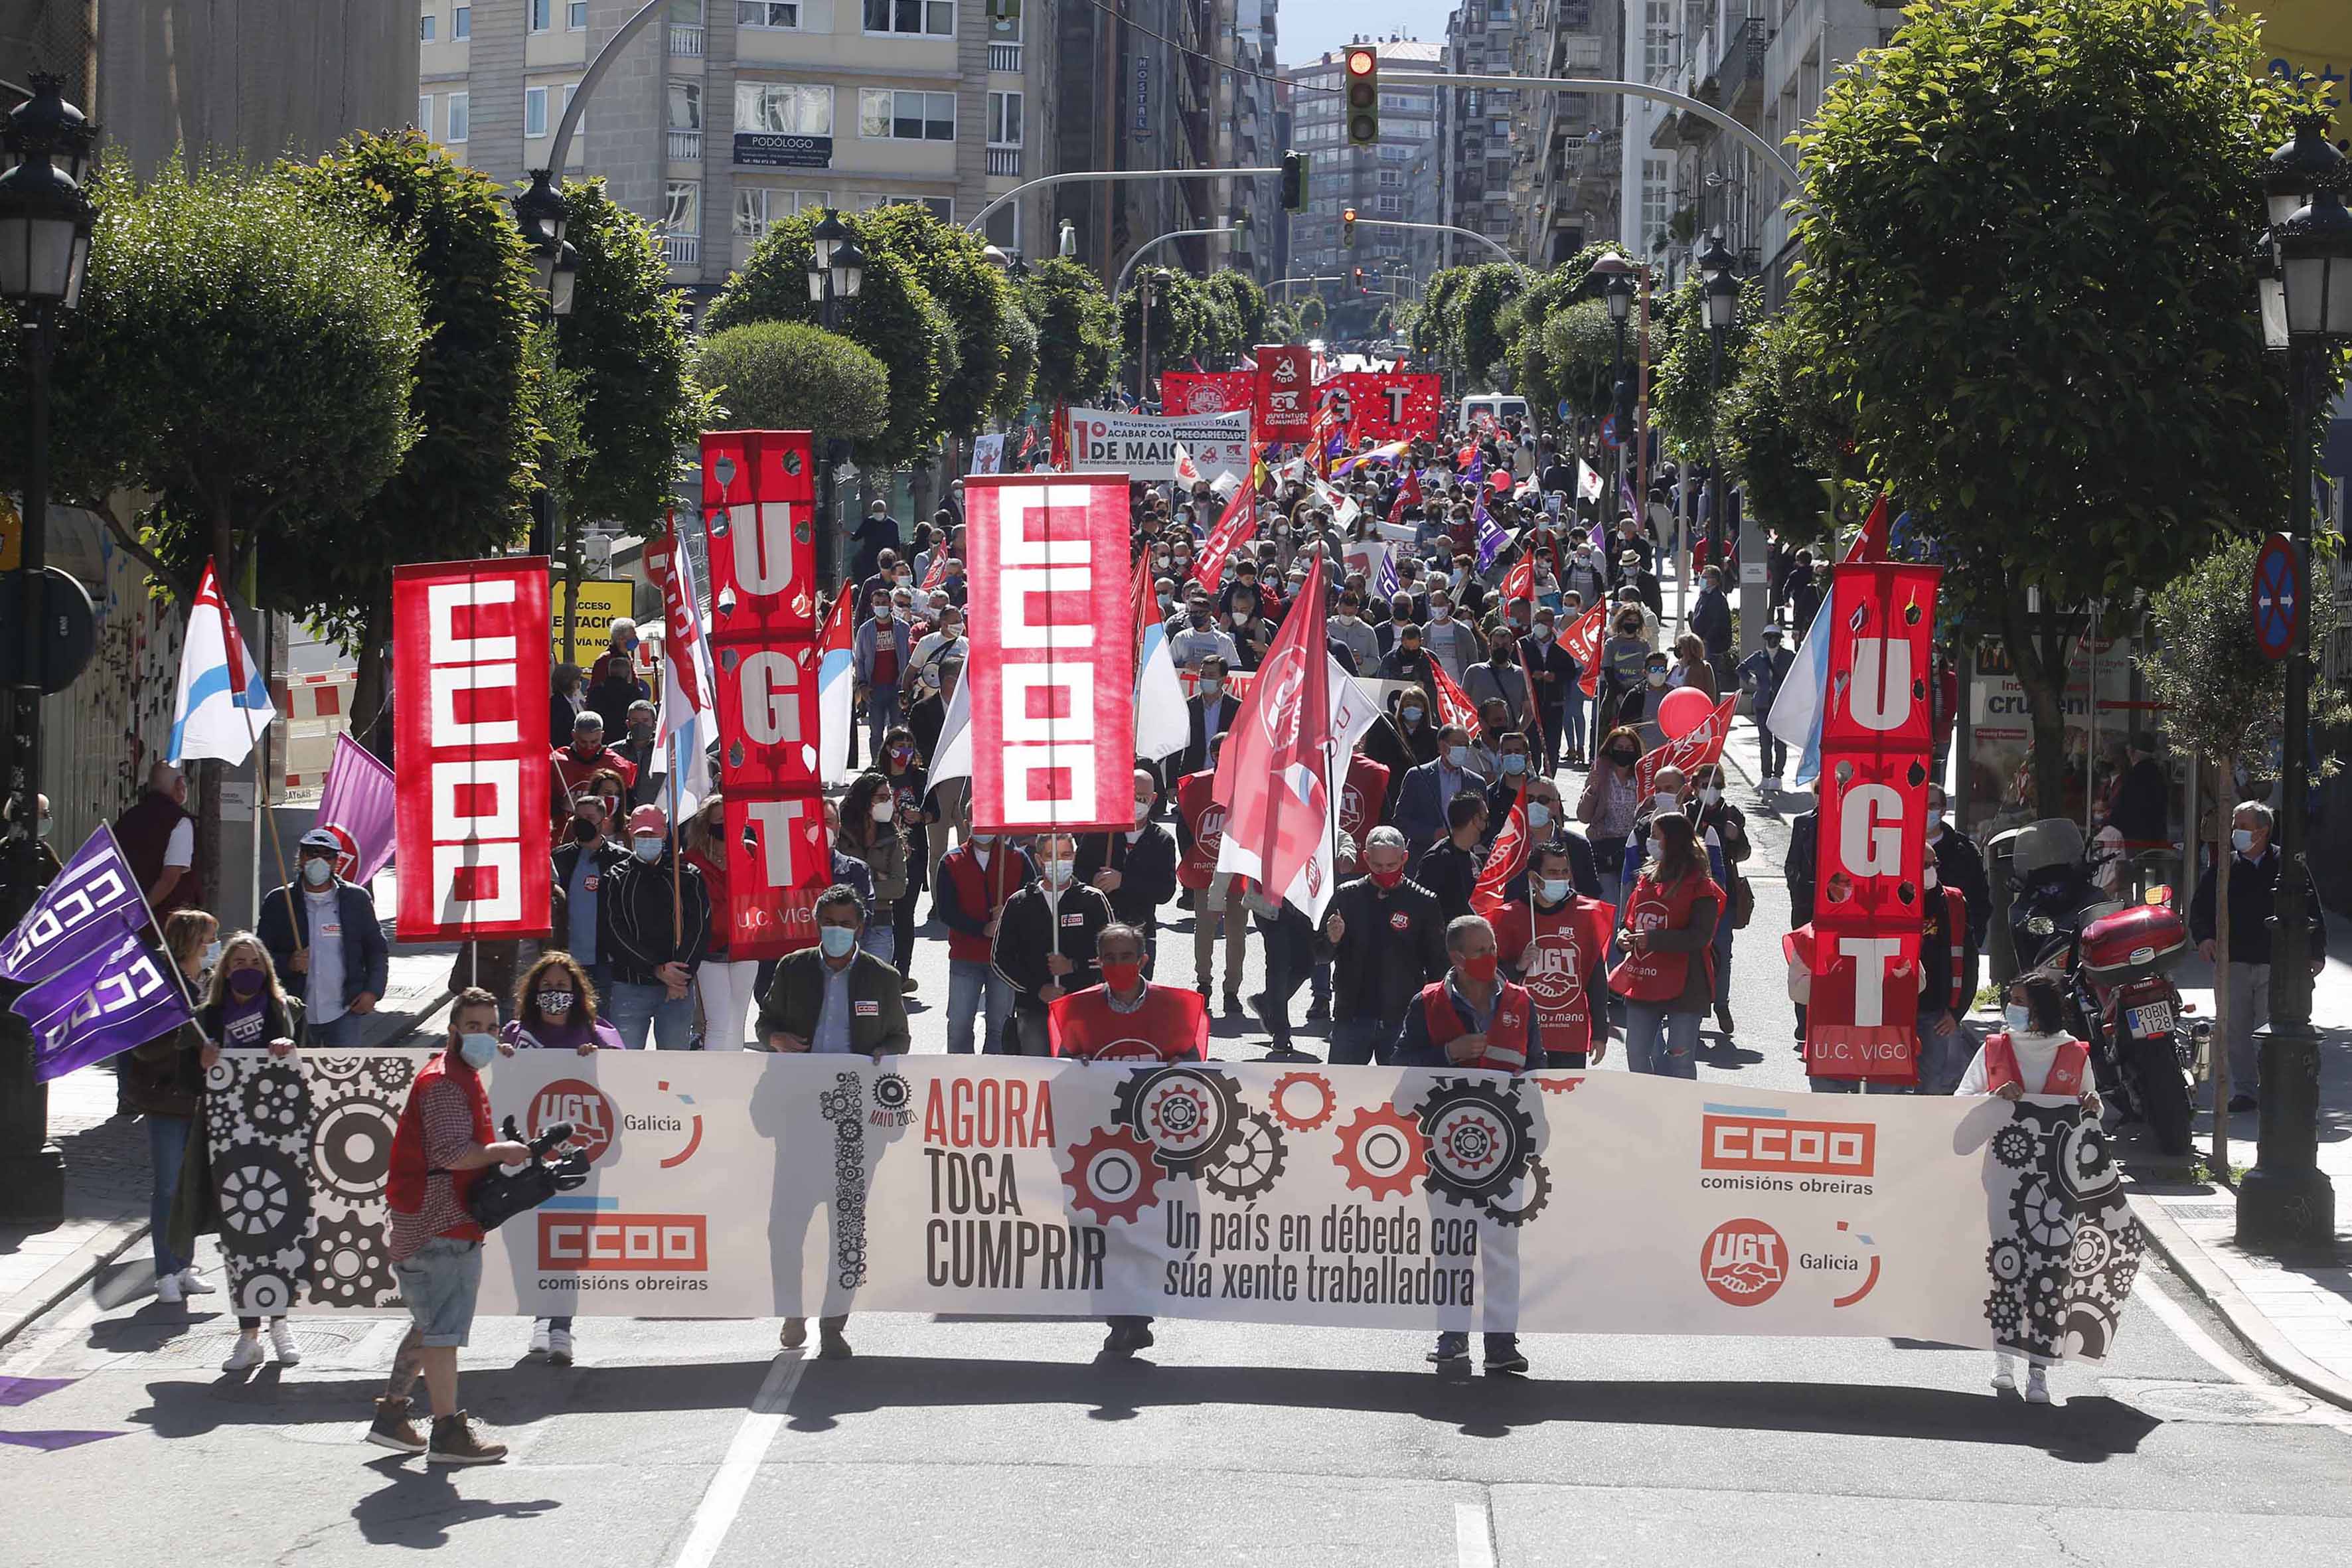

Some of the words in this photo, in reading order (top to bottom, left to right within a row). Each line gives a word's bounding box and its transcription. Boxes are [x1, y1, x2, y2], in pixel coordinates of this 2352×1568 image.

[1138, 58, 1147, 127] HOSTAL
[752, 135, 813, 149] PODÓLOGO
[1215, 419, 1240, 428] PARA
[1107, 429, 1147, 438] ACABAR
[1175, 430, 1247, 441] PRECARIEDADE
[1091, 441, 1117, 460] DE
[575, 601, 611, 610] CCESO
[576, 637, 592, 646] VÍA
[998, 485, 1097, 823] CCOO
[729, 502, 804, 888] UGT
[428, 580, 522, 925] CCOO
[1839, 638, 1911, 1027] UGT
[1559, 925, 1574, 935] UGT
[2133, 980, 2154, 990] YAMAHA
[1555, 1013, 1585, 1022] mano
[2142, 1016, 2171, 1033] 1128
[1816, 1042, 1855, 1060] U.C.
[1861, 1042, 1909, 1061] VIGO
[536, 1093, 601, 1130] UGT
[868, 1109, 894, 1127] MAIO
[896, 1109, 919, 1127] 2021
[924, 1077, 1057, 1148] AGORA
[624, 1114, 682, 1132] Galicia
[1713, 1126, 1864, 1166] CCOO
[923, 1147, 1023, 1216] TOCA
[1701, 1175, 1794, 1192] comisións
[1799, 1178, 1873, 1196] obreiras
[1166, 1200, 1200, 1251] Un
[1210, 1202, 1270, 1258] país
[1279, 1213, 1312, 1253] en
[1320, 1204, 1421, 1255] débeda
[1431, 1217, 1478, 1257] coa
[549, 1225, 696, 1260] CCOO
[1710, 1232, 1778, 1267] UGT
[926, 1219, 1107, 1291] CUMPRIR
[1799, 1253, 1859, 1271] Galicia
[538, 1275, 629, 1291] comisións
[635, 1275, 708, 1291] obreiras
[1164, 1251, 1213, 1298] súa
[1221, 1253, 1298, 1301] xente
[1306, 1254, 1475, 1307] traballadora
